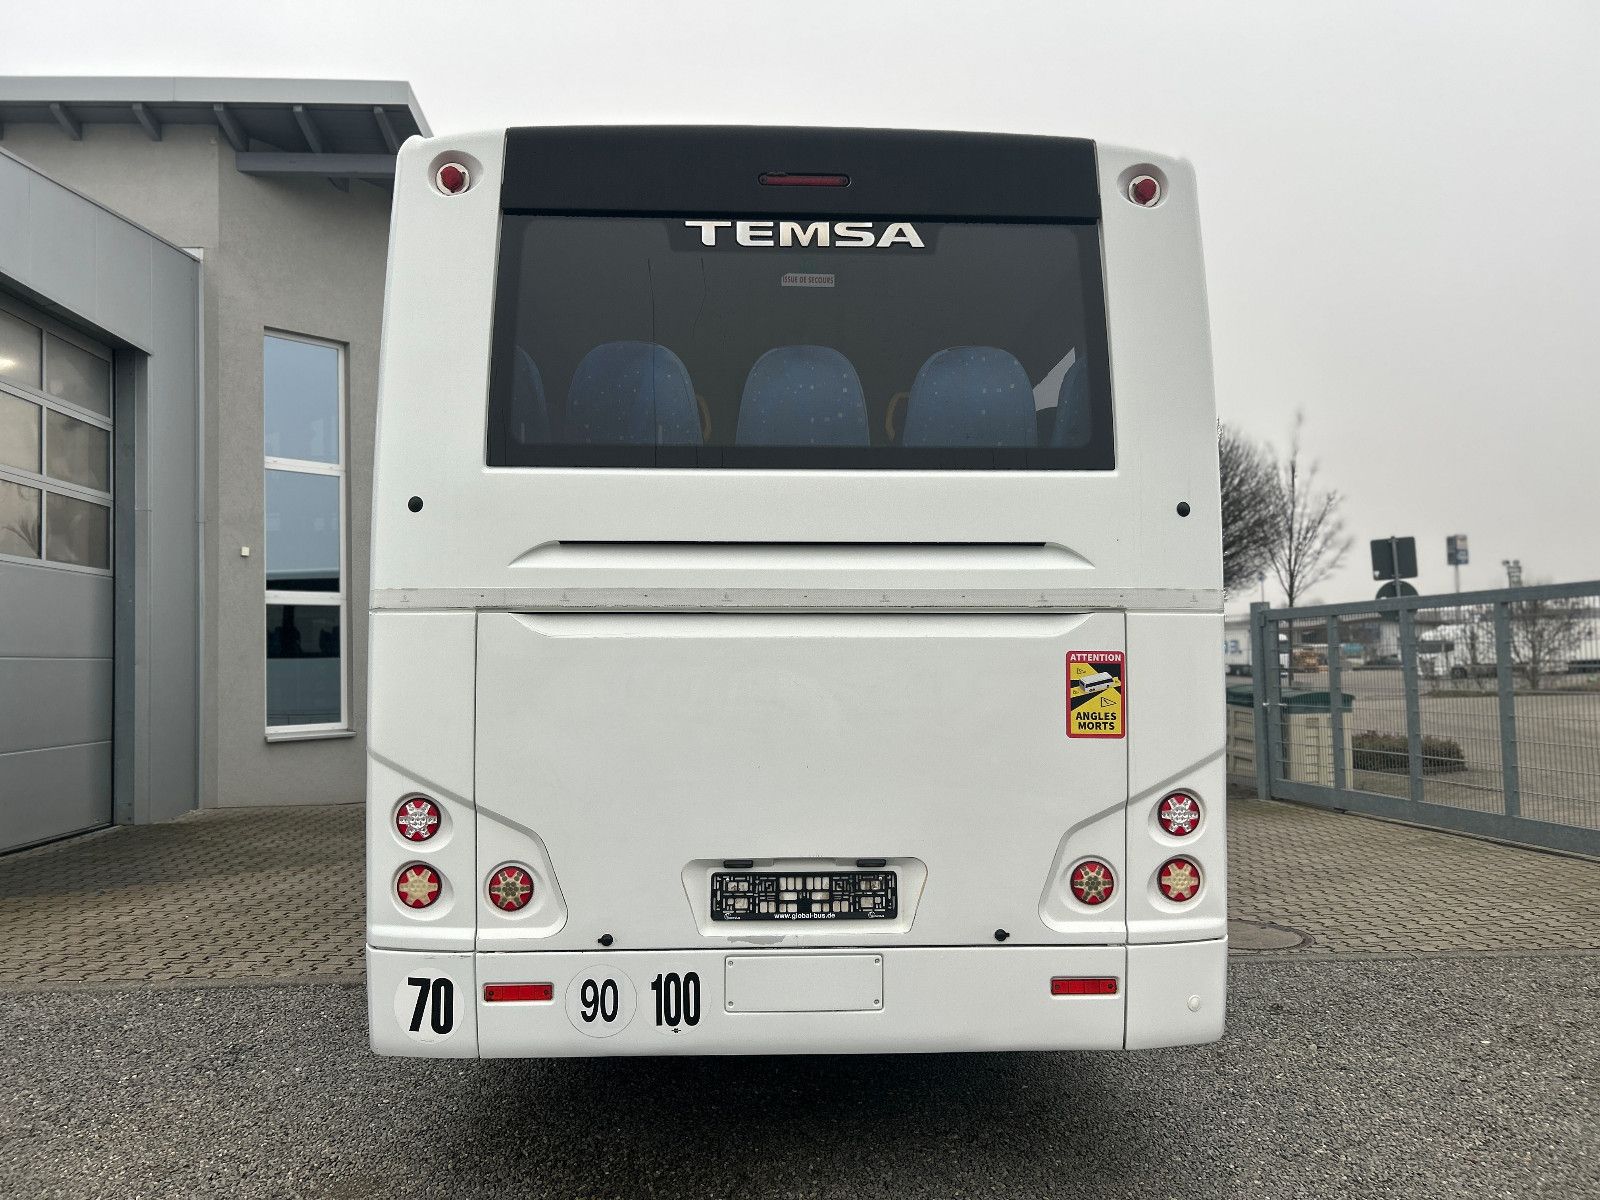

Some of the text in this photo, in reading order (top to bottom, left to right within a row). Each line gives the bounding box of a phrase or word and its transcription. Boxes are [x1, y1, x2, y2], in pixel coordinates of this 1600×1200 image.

[685, 221, 925, 248] TEMSA
[782, 275, 834, 284] ISSUE DE SECOURS
[1070, 653, 1121, 662] ATTENTION
[1076, 712, 1117, 721] ANGLES
[1078, 721, 1115, 731] MORTS
[774, 911, 836, 920] www.global-bus.de
[580, 978, 619, 1023] 90
[650, 971, 701, 1027] 100
[407, 976, 454, 1035] 70
